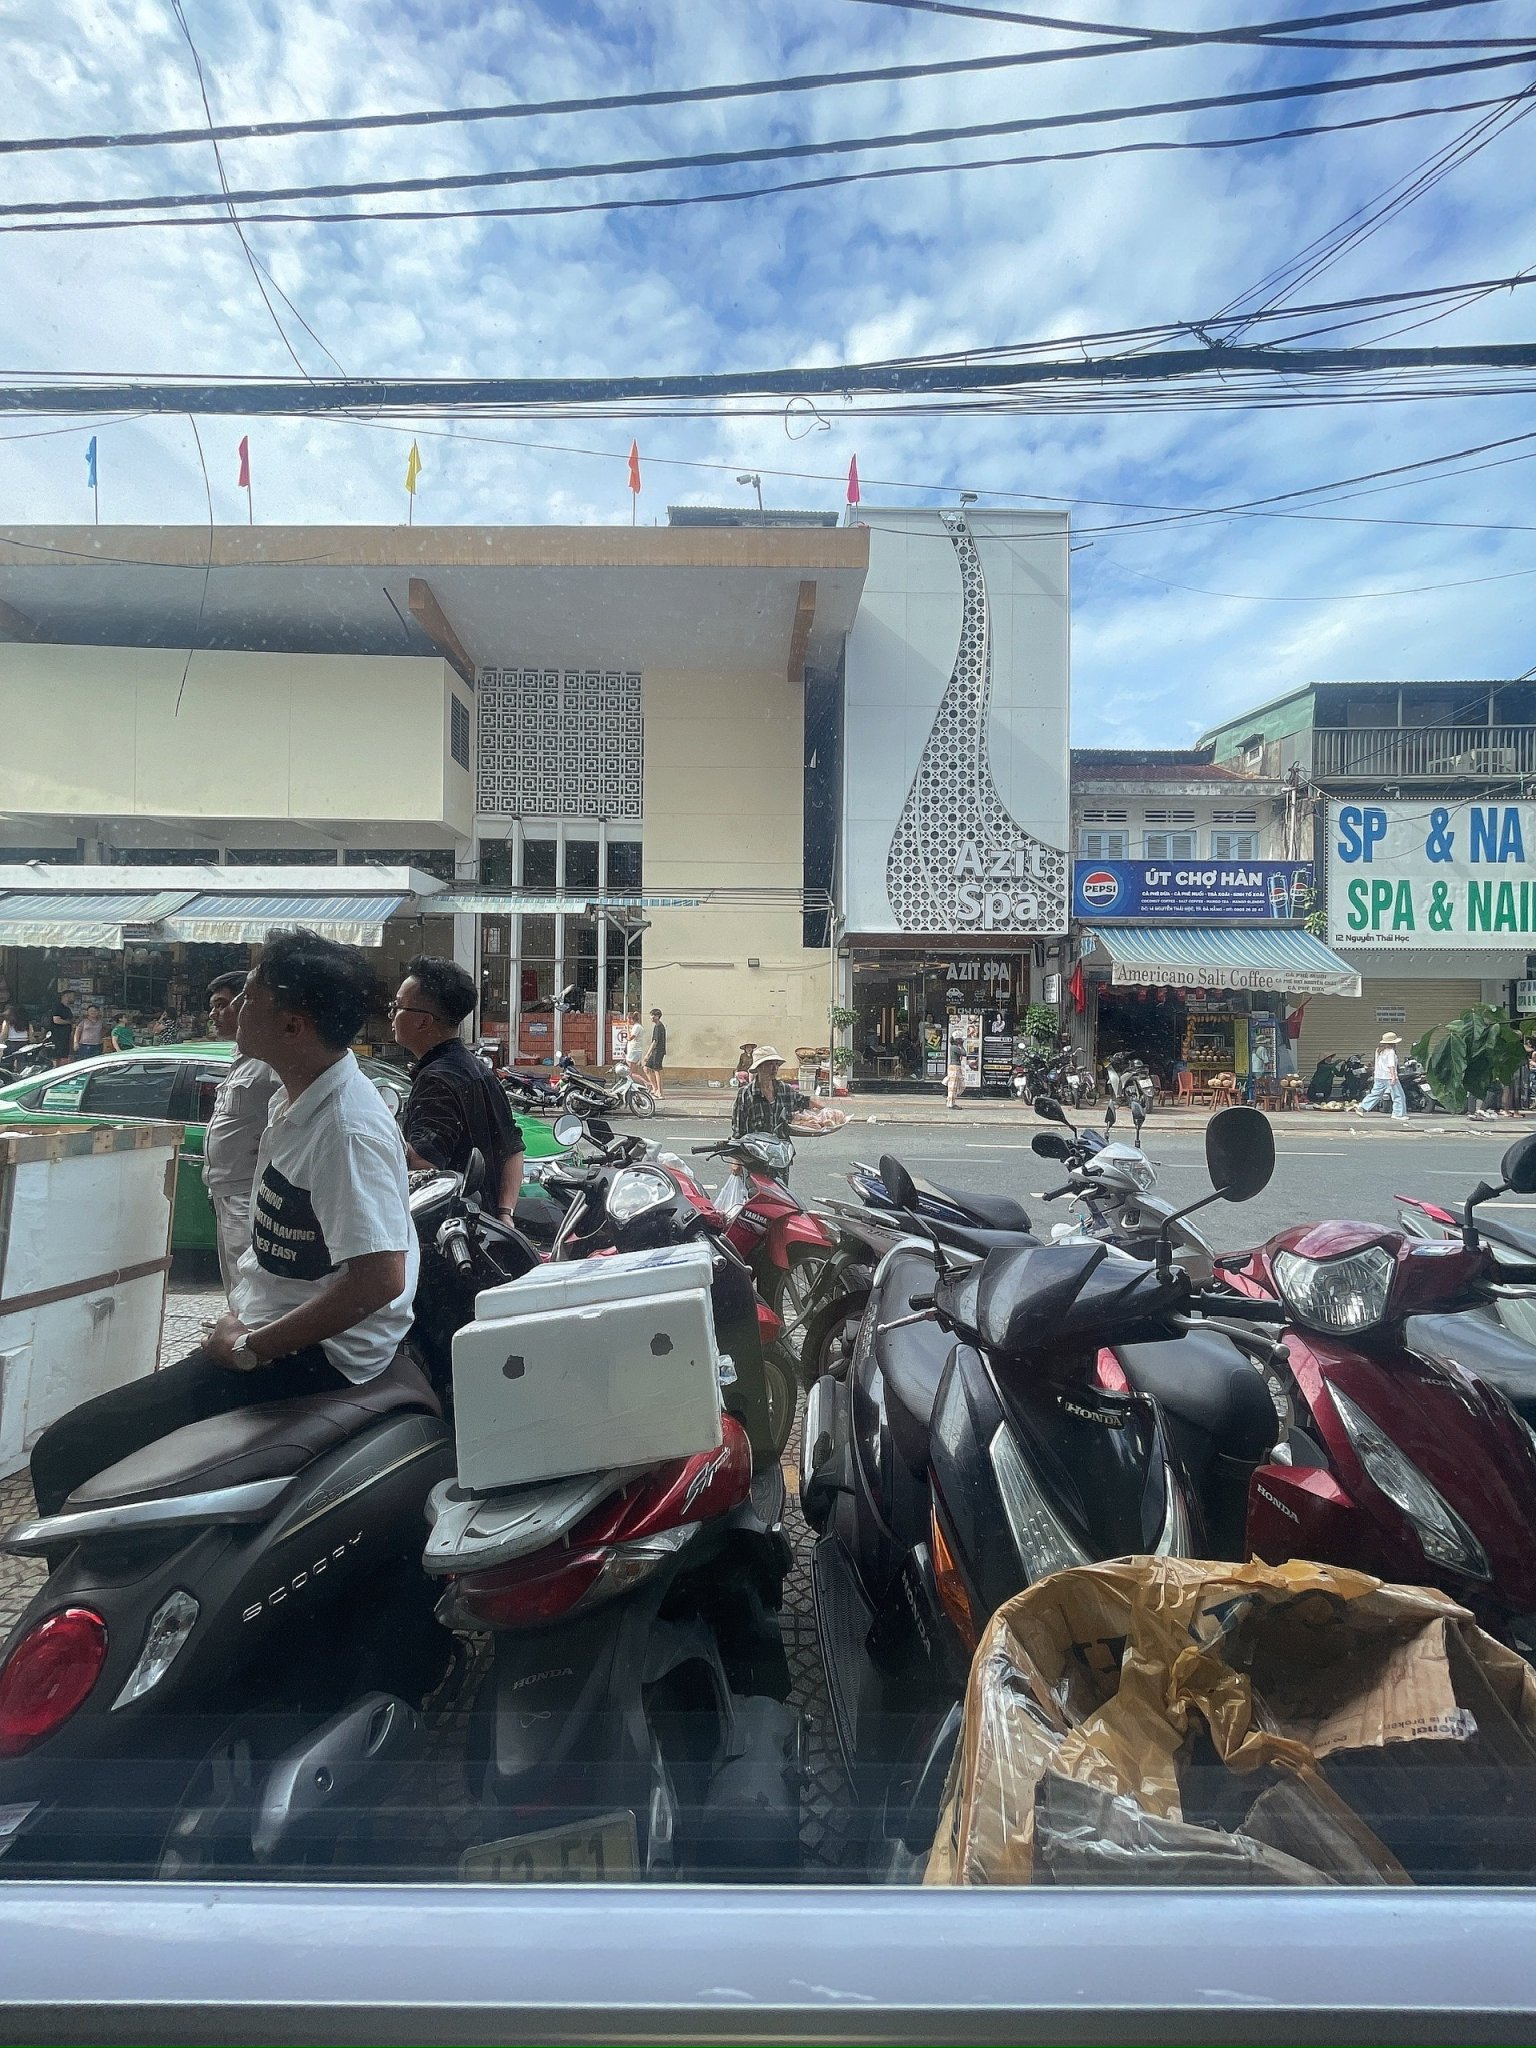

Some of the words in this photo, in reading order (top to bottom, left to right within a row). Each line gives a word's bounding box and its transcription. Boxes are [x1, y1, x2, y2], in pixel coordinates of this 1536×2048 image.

[1338, 806, 1387, 863] SP
[1426, 807, 1455, 863] &
[1470, 807, 1525, 863] NA
[953, 838, 1046, 878] Azit
[1085, 885, 1116, 893] PEPSI
[1145, 867, 1171, 886] ÚT
[1175, 869, 1218, 889] CHỢ
[1221, 868, 1262, 886] HÀN
[956, 883, 1039, 930] Spa
[1347, 878, 1416, 931] SPA
[1428, 880, 1454, 932] &
[1345, 933, 1374, 943] Nguyễn
[1376, 934, 1393, 942] Thái
[1394, 934, 1410, 943] Học
[946, 962, 981, 980] AZIT
[983, 962, 1009, 980] SPA
[1118, 963, 1194, 984] Americano
[1198, 967, 1226, 986] Salt
[1230, 969, 1273, 988] Coffee
[744, 1210, 768, 1225] YAMAHA
[273, 1221, 316, 1241] HAVING
[271, 1243, 297, 1262] EASY
[1065, 1401, 1123, 1427] HONDA
[1256, 1483, 1300, 1525] HONDA
[242, 1530, 364, 1624] SCOOPY
[511, 1667, 575, 1691] HONDA
[1383, 1717, 1425, 1731] broken
